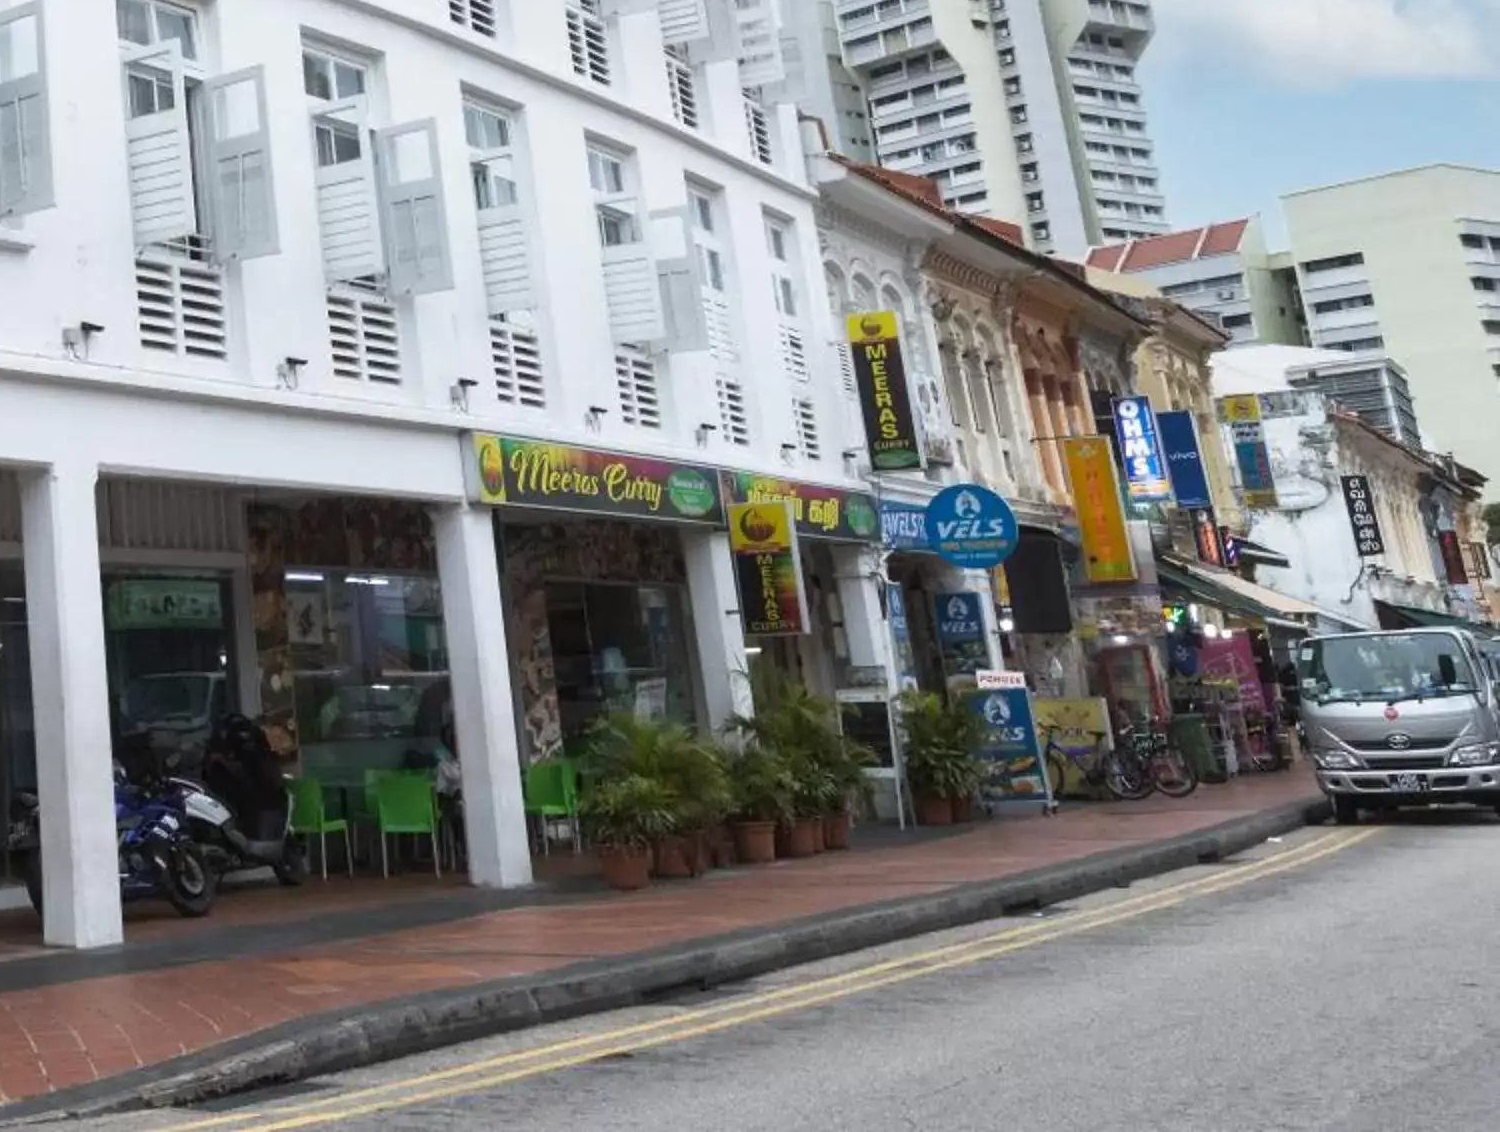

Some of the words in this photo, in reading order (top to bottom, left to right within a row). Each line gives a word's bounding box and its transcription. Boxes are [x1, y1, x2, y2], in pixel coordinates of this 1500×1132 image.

[864, 343, 899, 439] MEERAS
[1118, 400, 1152, 476] OHMS
[509, 448, 599, 496] Meeras
[603, 462, 663, 511] Curry
